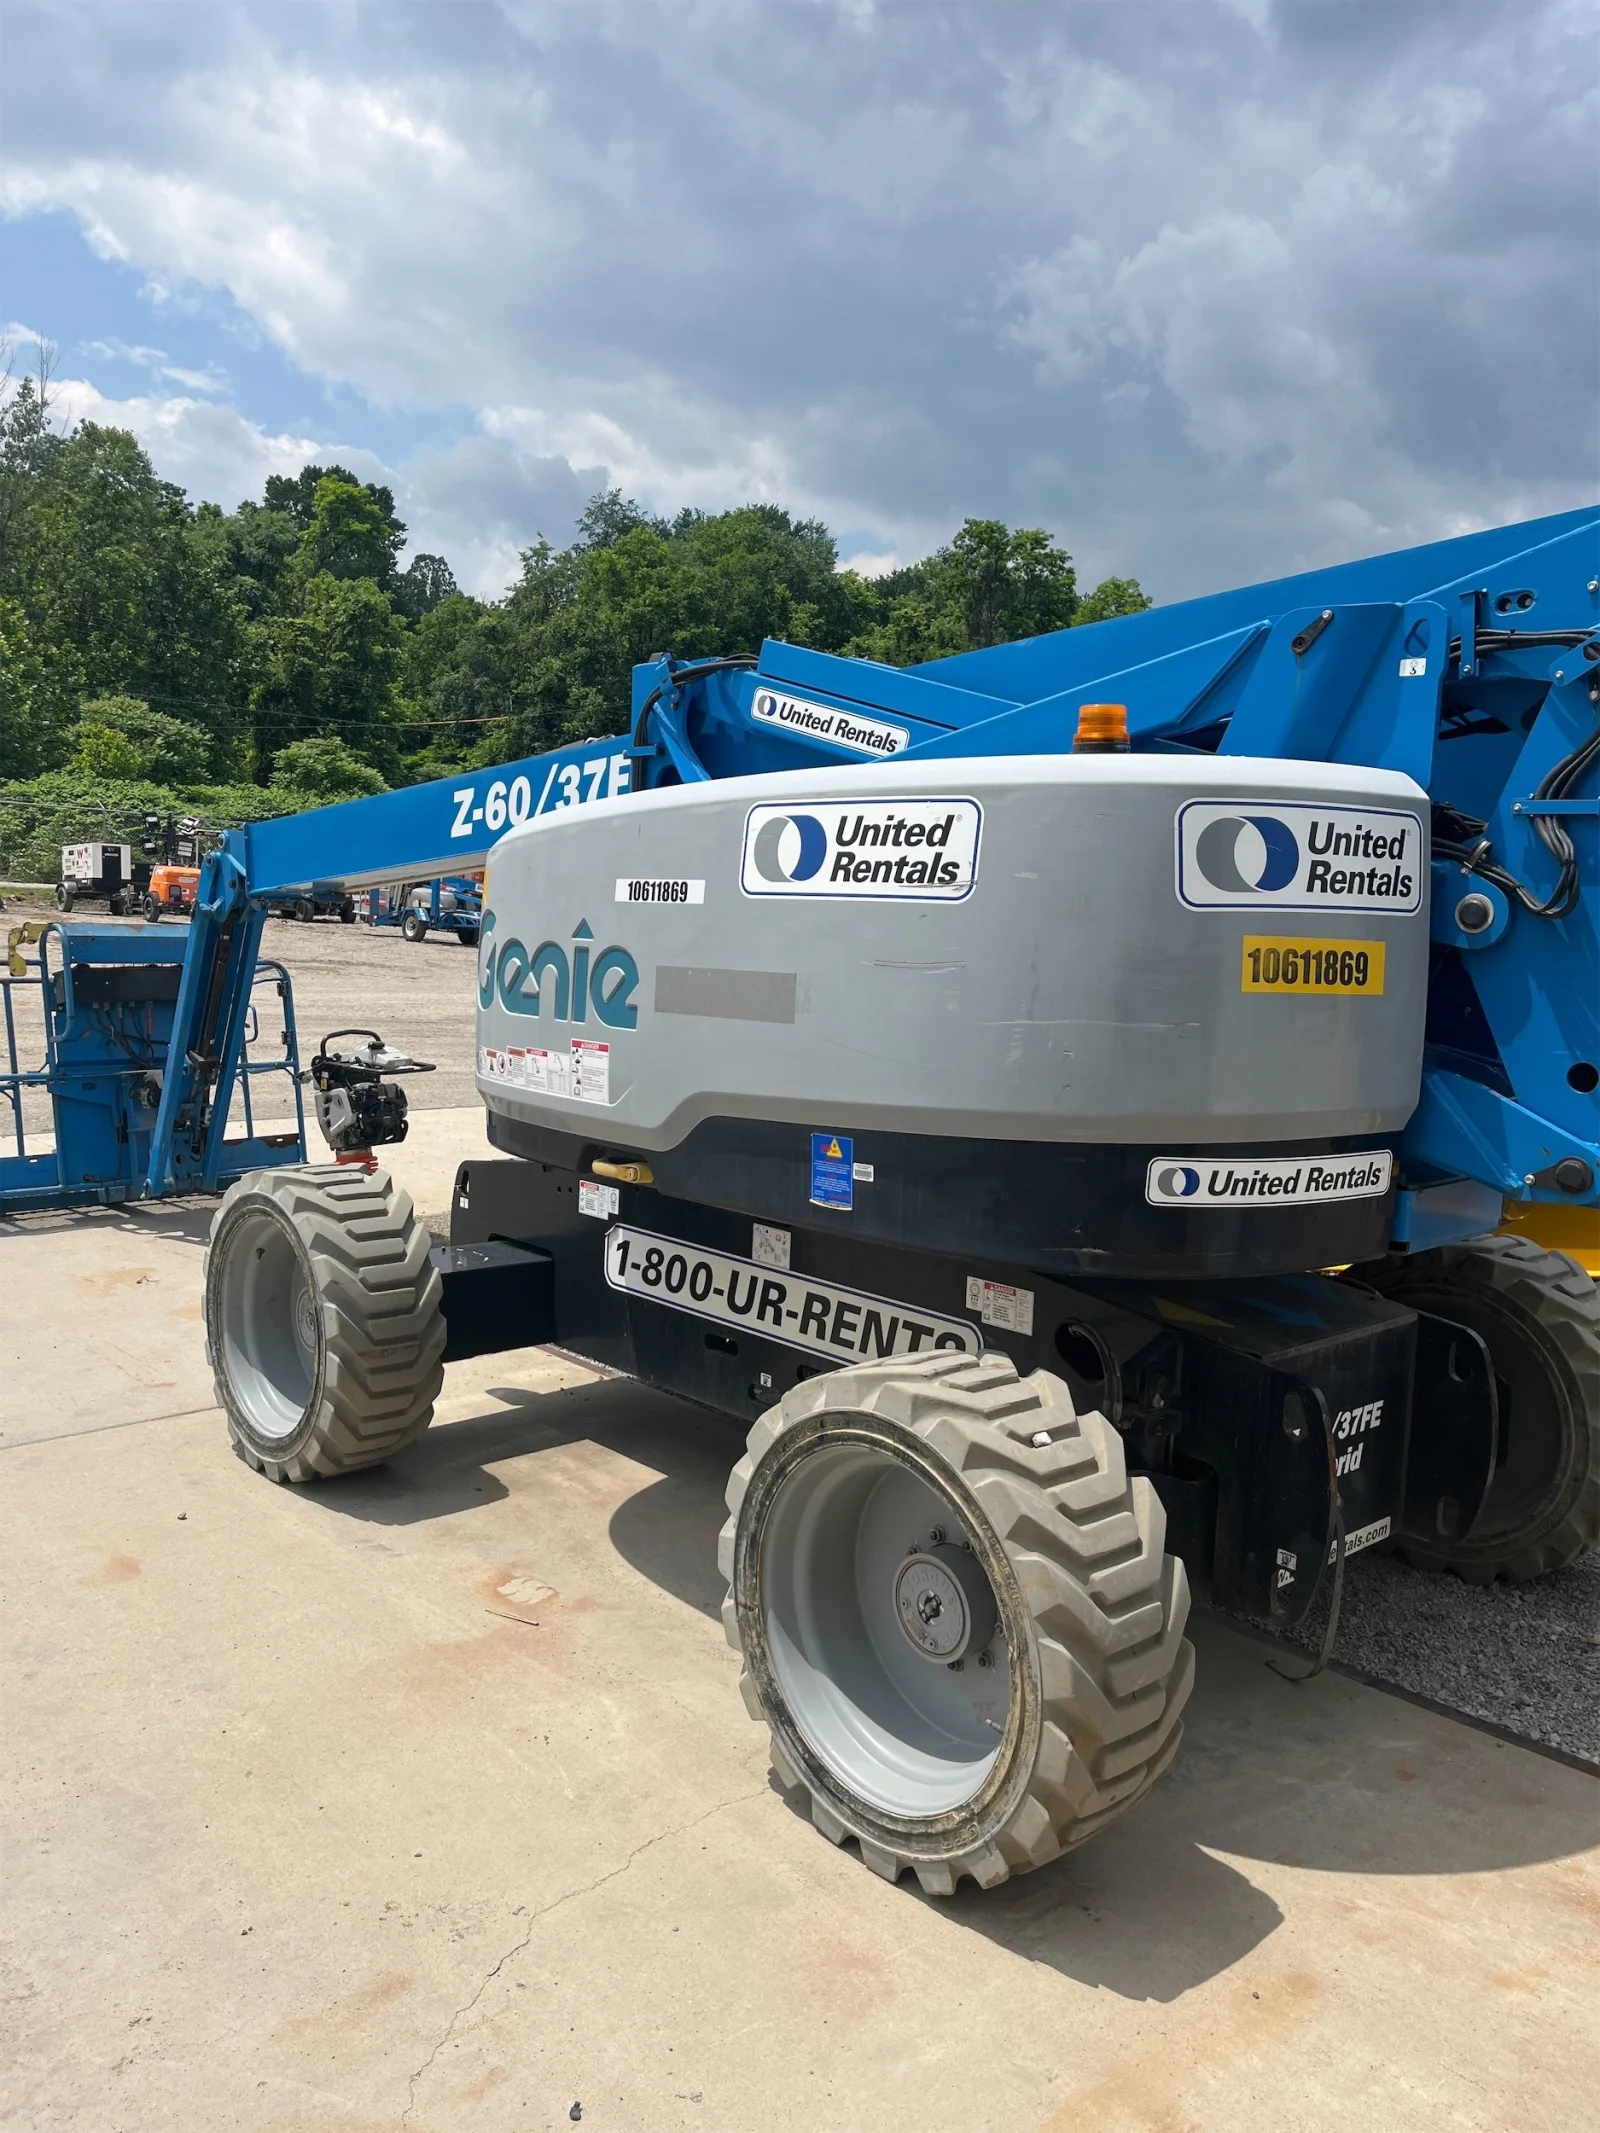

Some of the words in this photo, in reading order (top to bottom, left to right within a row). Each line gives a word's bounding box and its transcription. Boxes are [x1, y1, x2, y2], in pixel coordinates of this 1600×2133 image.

[779, 702, 834, 733] United
[834, 718, 898, 752] Rentals
[835, 814, 955, 847] United
[1307, 821, 1406, 861] United
[829, 851, 960, 884] Rentals
[1305, 859, 1413, 898] Rentals
[627, 880, 689, 903] 10611869
[477, 908, 640, 1032] Genie
[1247, 947, 1370, 987] 10611869
[1207, 1168, 1302, 1197] United
[1304, 1161, 1382, 1193] Rentals
[1335, 1442, 1364, 1477] rid
